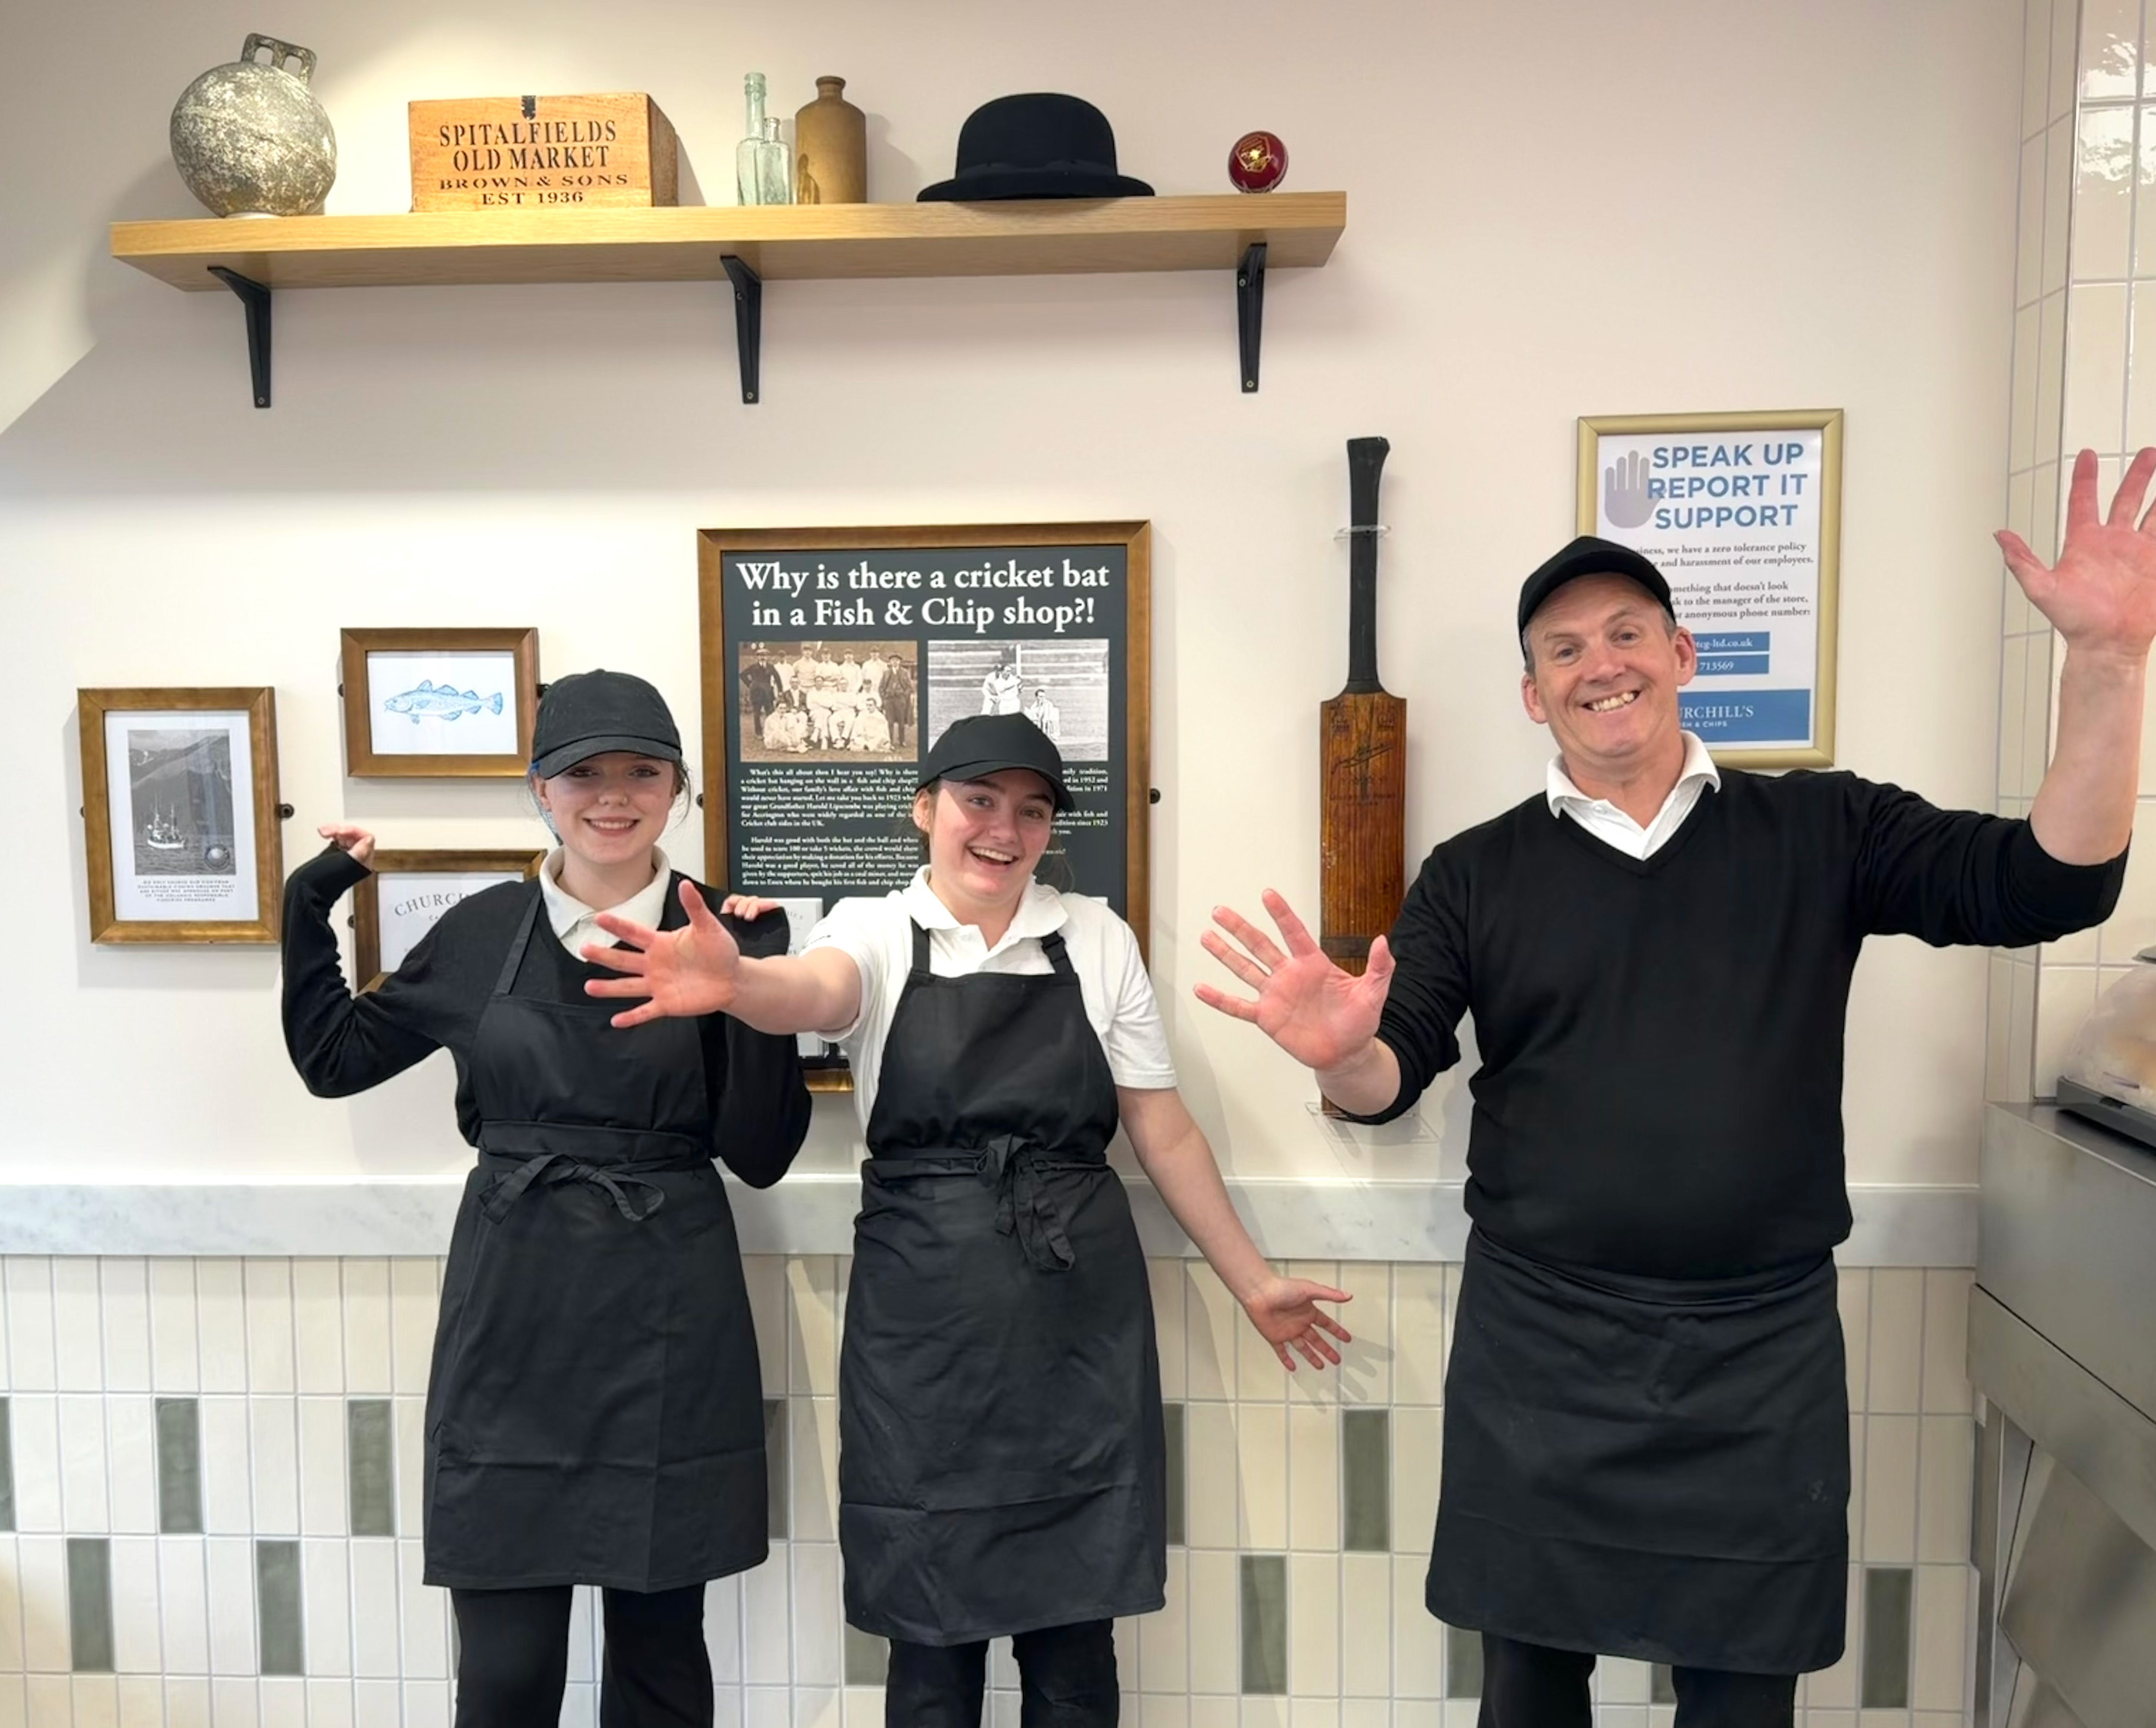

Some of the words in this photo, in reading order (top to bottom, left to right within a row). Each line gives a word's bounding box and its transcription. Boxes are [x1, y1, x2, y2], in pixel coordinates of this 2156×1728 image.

[440, 119, 617, 147] SPITALFIELDS
[453, 149, 501, 172] OLD
[509, 146, 609, 169] MARKET
[440, 178, 528, 189] BROWN
[537, 176, 552, 186] &
[562, 175, 628, 185] SONS
[483, 193, 525, 205] EST
[538, 192, 583, 203] 1936
[1653, 444, 1753, 468] SPEAK
[1764, 444, 1803, 465] UP
[1647, 474, 1769, 499] REPORT
[1781, 473, 1808, 496] IT
[1655, 504, 1798, 529] SUPPORT
[1682, 544, 1702, 553] have
[1733, 543, 1775, 553] tolerance
[1777, 541, 1806, 553] policy
[1660, 558, 1677, 567] and
[1680, 557, 1731, 566] harassment
[1733, 556, 1744, 565] of
[736, 562, 809, 597] Why
[817, 564, 839, 589] is
[848, 561, 921, 589] there
[930, 571, 946, 588] a
[955, 560, 1054, 588] cricket
[1063, 559, 1109, 586] bat
[1713, 582, 1731, 591] that
[1733, 581, 1765, 591] doesn't
[1768, 581, 1788, 590] look
[1696, 597, 1710, 605] the
[1713, 598, 1751, 607] manager
[1753, 594, 1764, 603] of
[1766, 594, 1780, 603] the
[753, 601, 781, 625] in
[790, 609, 806, 625] a
[814, 598, 875, 625] Fish
[885, 600, 913, 625] &
[922, 597, 994, 633] Chip
[1003, 596, 1094, 632] shop?!
[1739, 608, 1768, 619] phone
[1696, 638, 1753, 650] tcg-ltd.co.uk
[1700, 661, 1734, 671] 713569
[1680, 705, 1754, 719] RCHILL'S
